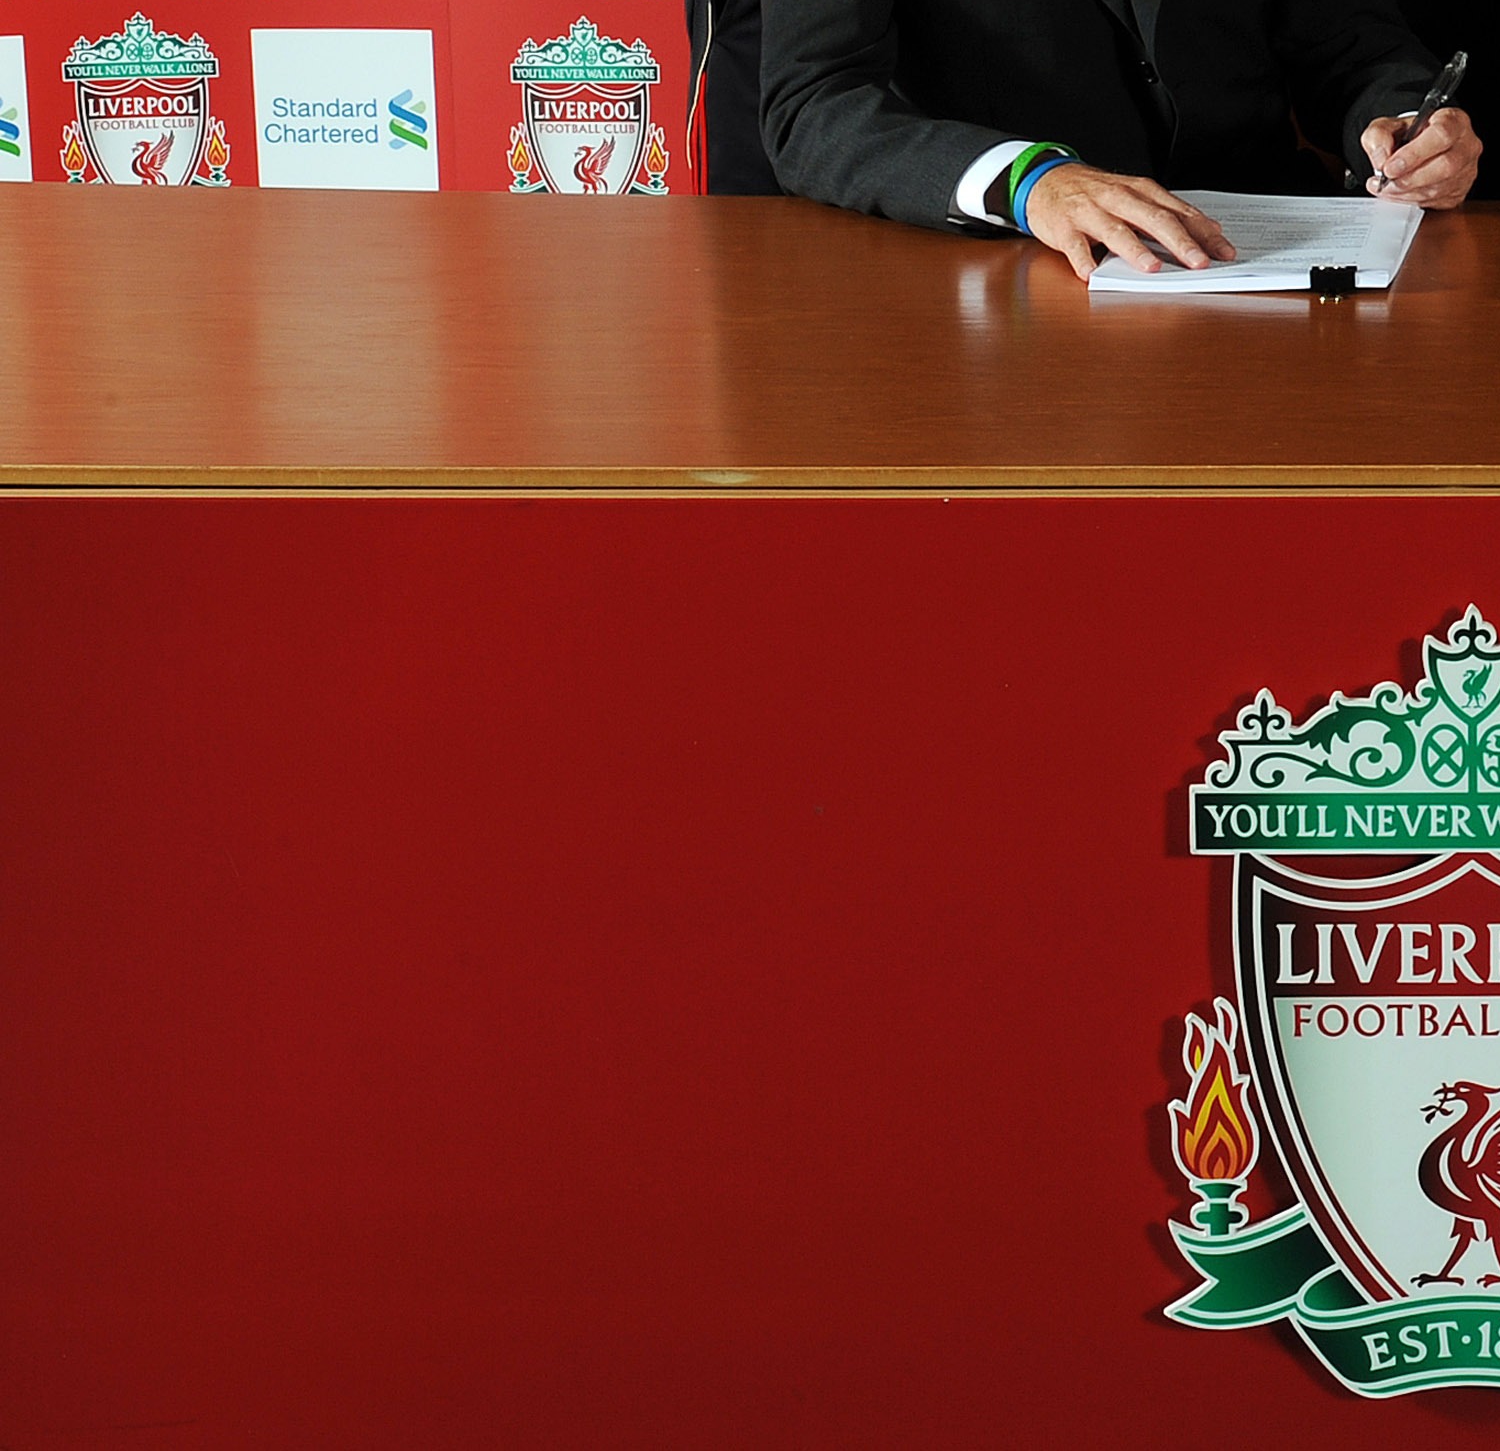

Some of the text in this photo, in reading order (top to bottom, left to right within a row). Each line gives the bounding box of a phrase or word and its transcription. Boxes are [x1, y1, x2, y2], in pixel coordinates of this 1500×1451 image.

[66, 63, 215, 77] YOU'LL NEVER WALK ALONE
[514, 69, 655, 79] YOU'LL NEVER WALK ALONE
[88, 96, 199, 117] LIVERPOOL
[273, 98, 377, 117] Standard
[534, 101, 640, 120] LIVERPOOL
[94, 118, 195, 131] FOOTBALL CLUB
[265, 124, 378, 143] Chartered
[539, 124, 635, 134] FOOTBALL CLUB
[1204, 805, 1336, 837] YOU'LL
[1345, 806, 1473, 837] NEVER
